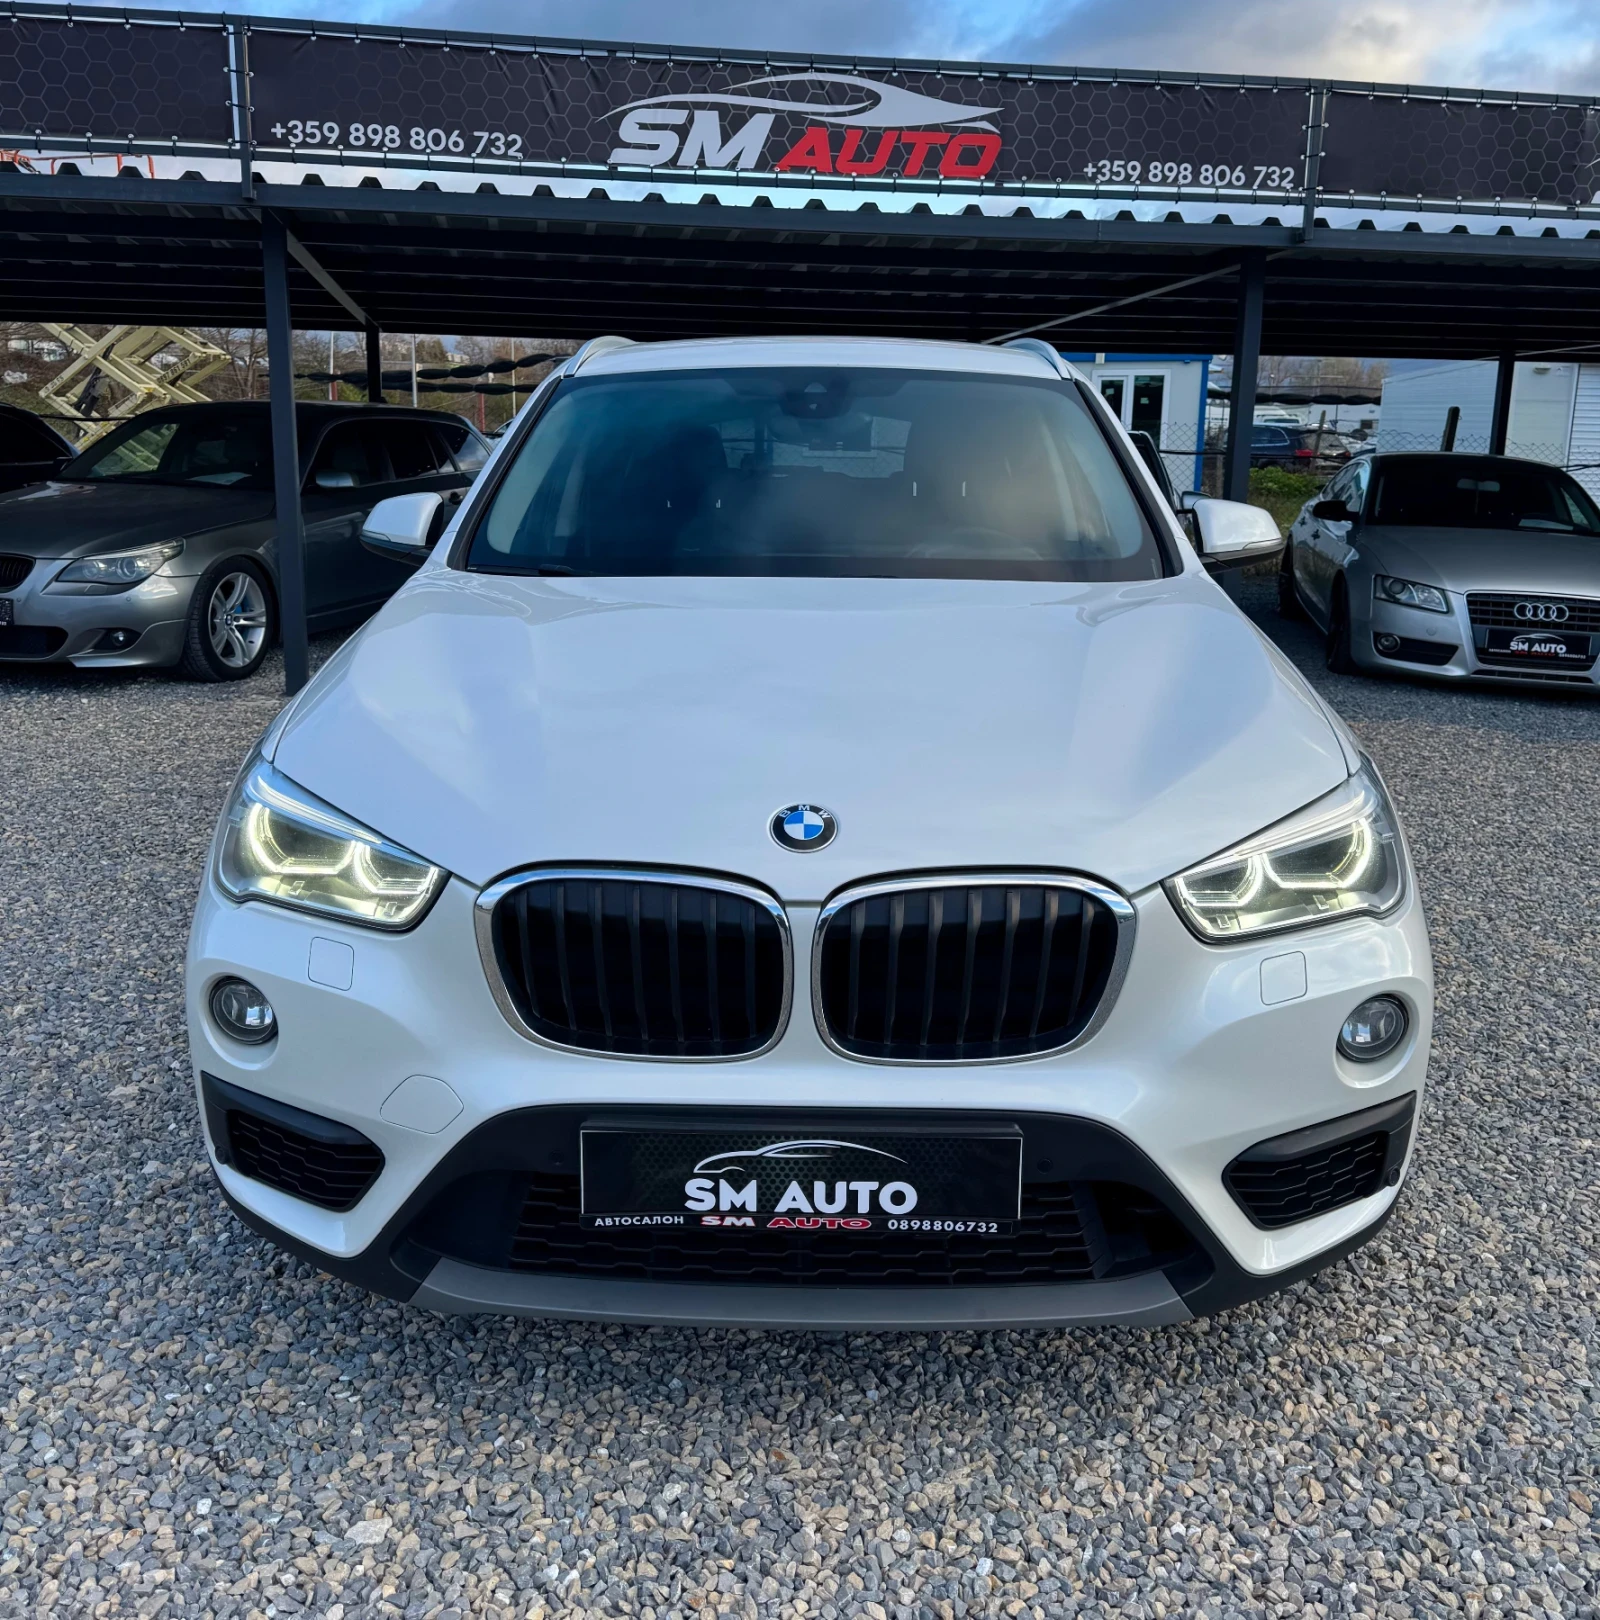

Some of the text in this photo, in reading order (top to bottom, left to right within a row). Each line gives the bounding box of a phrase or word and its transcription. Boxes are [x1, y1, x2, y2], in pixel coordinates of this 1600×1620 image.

[271, 120, 524, 159] +359 898 806 732
[607, 108, 1002, 178] SM AUTO
[1083, 159, 1295, 191] +359 898 806 732
[1509, 641, 1529, 652] SM
[1531, 643, 1567, 654] AUTO
[778, 805, 831, 819] BMW
[684, 1178, 918, 1215] SM AUTO
[594, 1215, 998, 1233] АВТОСАЛОН SM AUTO 0898806732
